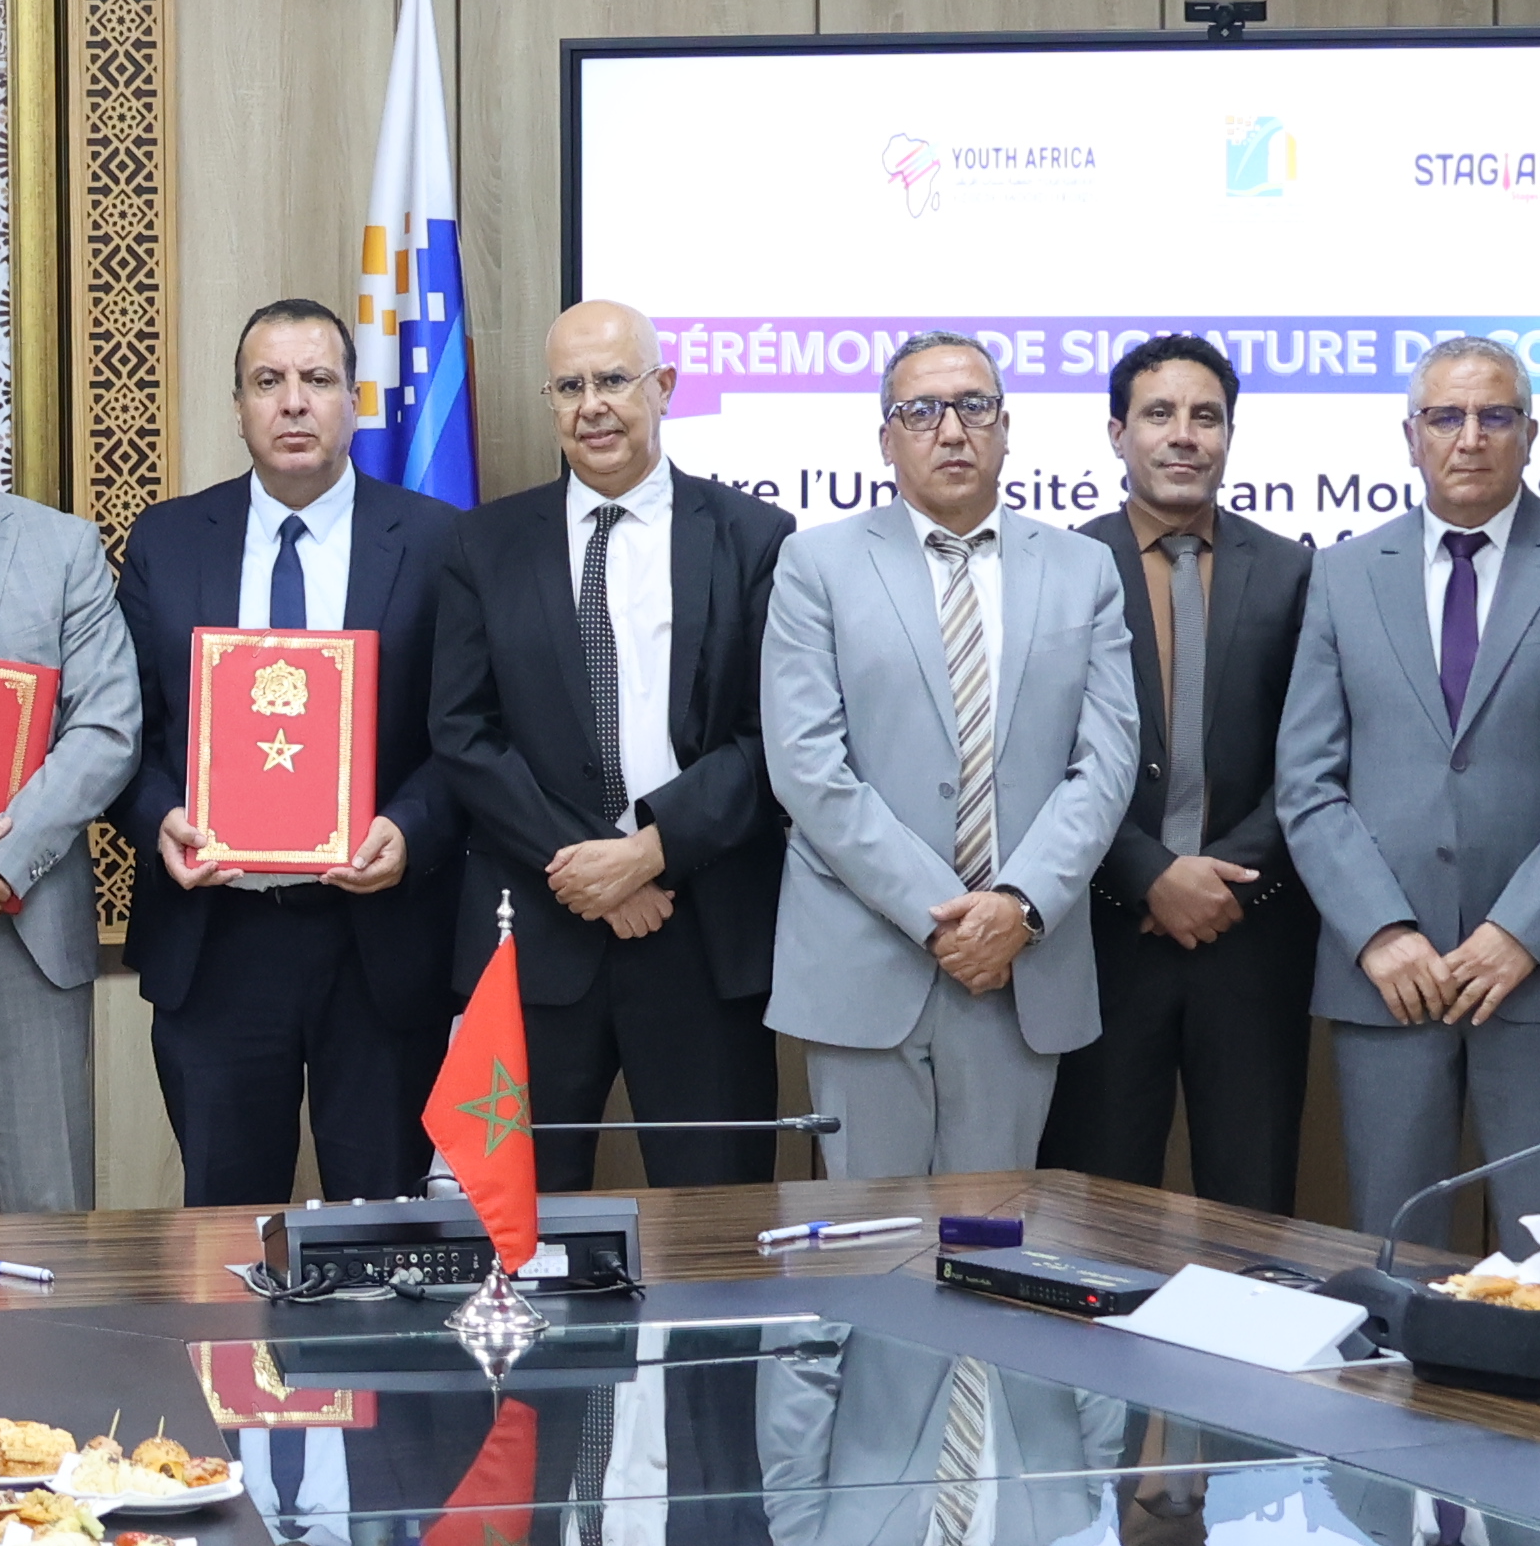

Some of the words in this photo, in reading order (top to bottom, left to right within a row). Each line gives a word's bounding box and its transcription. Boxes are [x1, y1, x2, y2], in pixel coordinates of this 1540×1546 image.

[951, 146, 1018, 170] YOUTH
[1024, 146, 1097, 169] AFRICA
[656, 323, 922, 375] CÉRÉMON
[1060, 329, 1378, 375] SITURE
[1394, 329, 1466, 374] D
